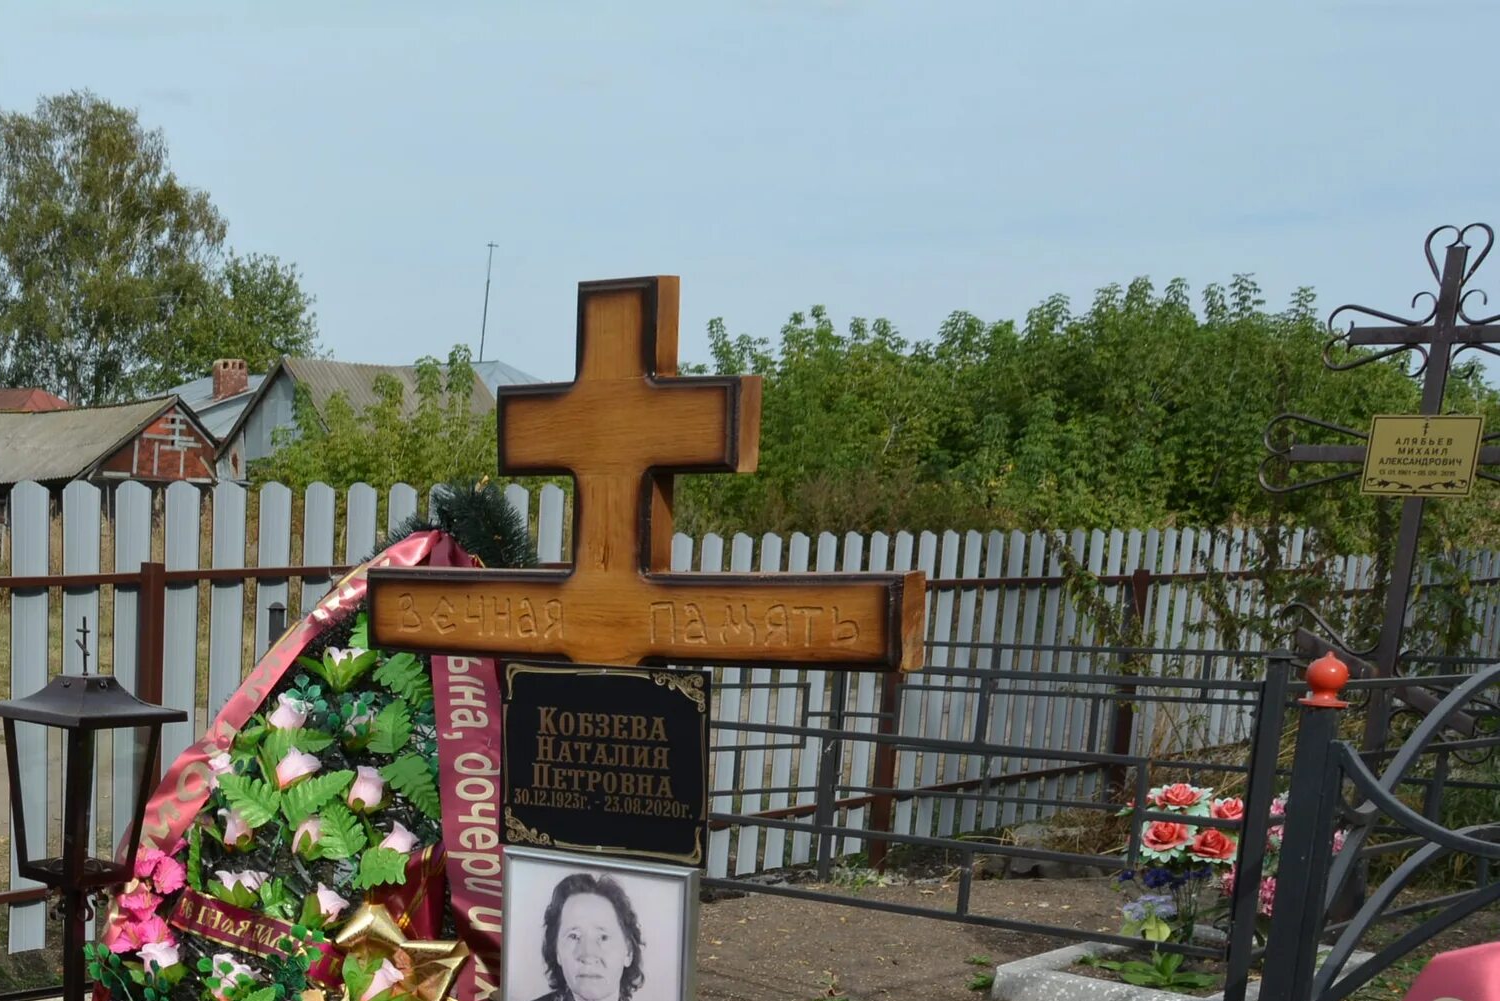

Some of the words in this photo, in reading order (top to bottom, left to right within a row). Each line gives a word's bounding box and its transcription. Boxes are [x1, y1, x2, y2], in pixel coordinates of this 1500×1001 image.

[1395, 437, 1454, 446] АЛЯБЬЕВ
[1398, 447, 1449, 456] МИХАИЛ
[1378, 457, 1463, 467] АЛЕКСАНДРОВИЧ
[443, 656, 490, 740] ына,
[537, 706, 669, 742] КОБЗЕВА
[536, 735, 671, 770] НАТАЛИЯ
[531, 762, 674, 799] ПЕТРОВНА
[447, 752, 502, 897] дочери
[603, 795, 693, 819] 23.08.2020г.
